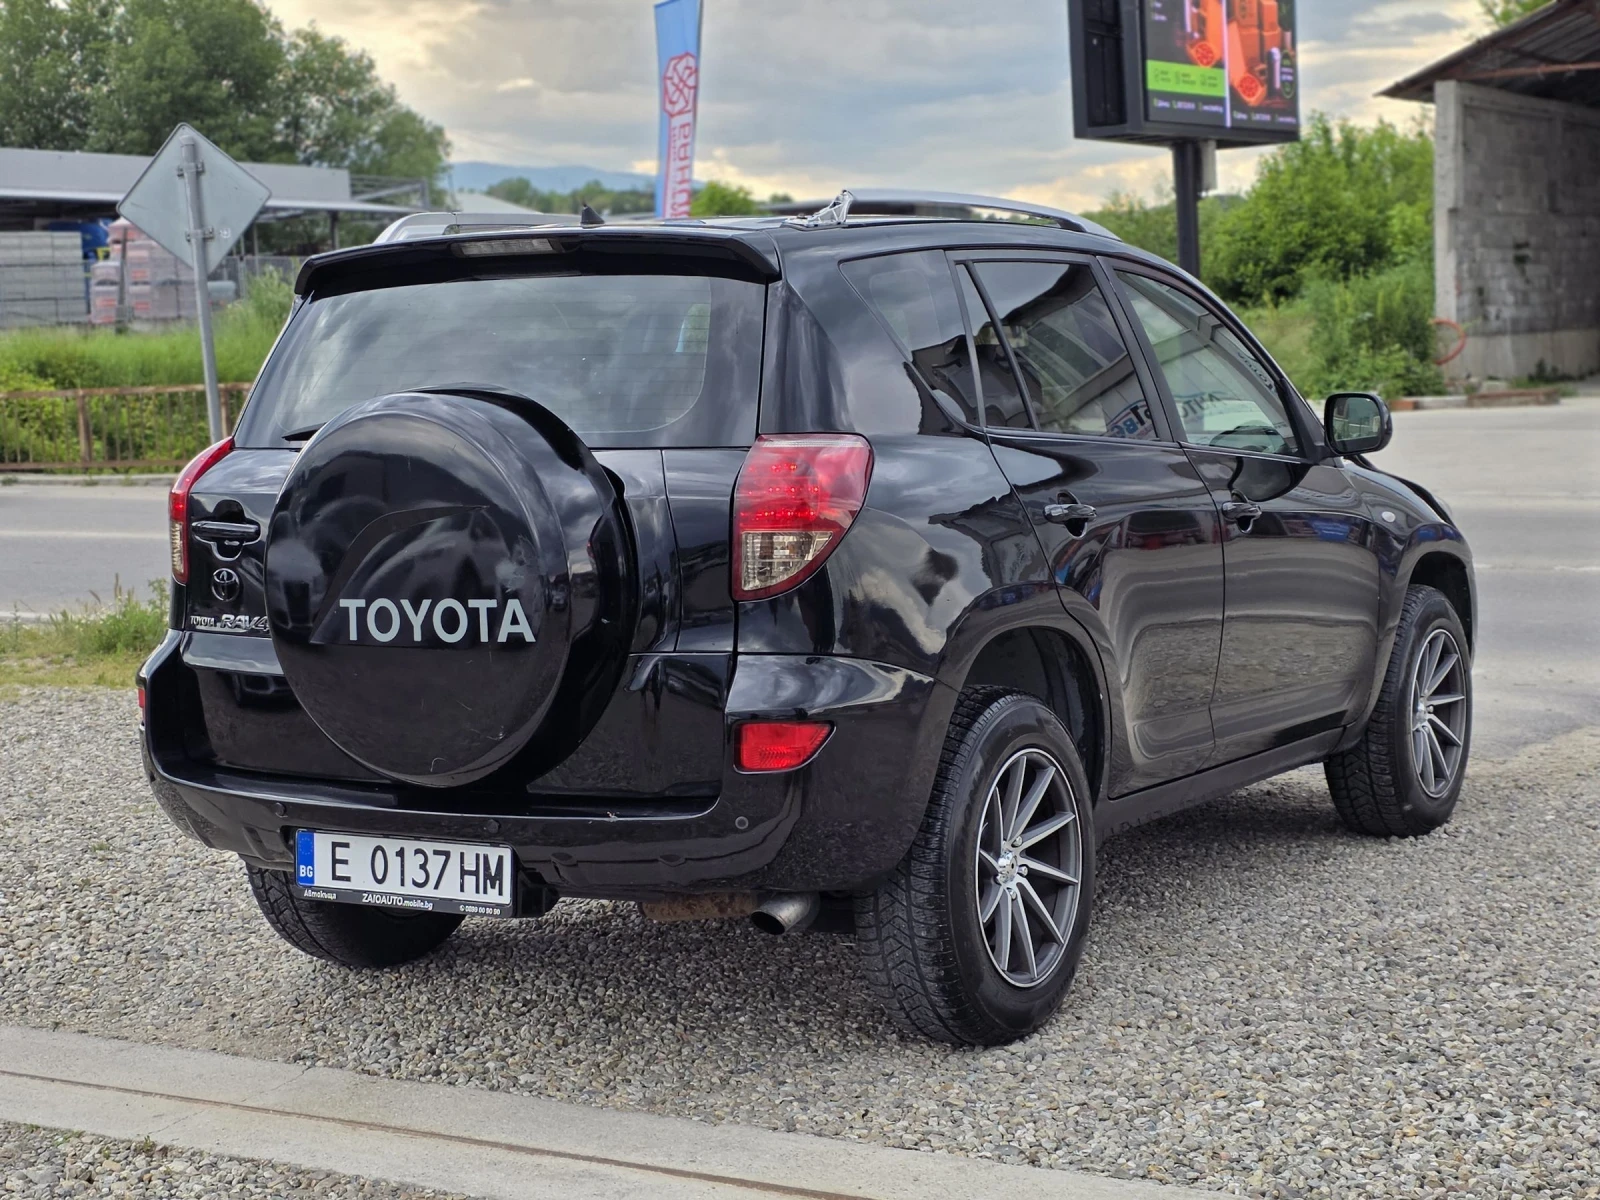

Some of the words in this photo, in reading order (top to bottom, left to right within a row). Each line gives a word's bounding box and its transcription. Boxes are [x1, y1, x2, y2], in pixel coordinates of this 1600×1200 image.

[190, 615, 215, 627] TOYOTA
[221, 613, 269, 632] RAV4
[339, 597, 536, 643] TOYOTA
[299, 864, 314, 878] BG
[331, 841, 351, 883] E
[370, 844, 451, 890] 0137
[459, 851, 504, 897] HM
